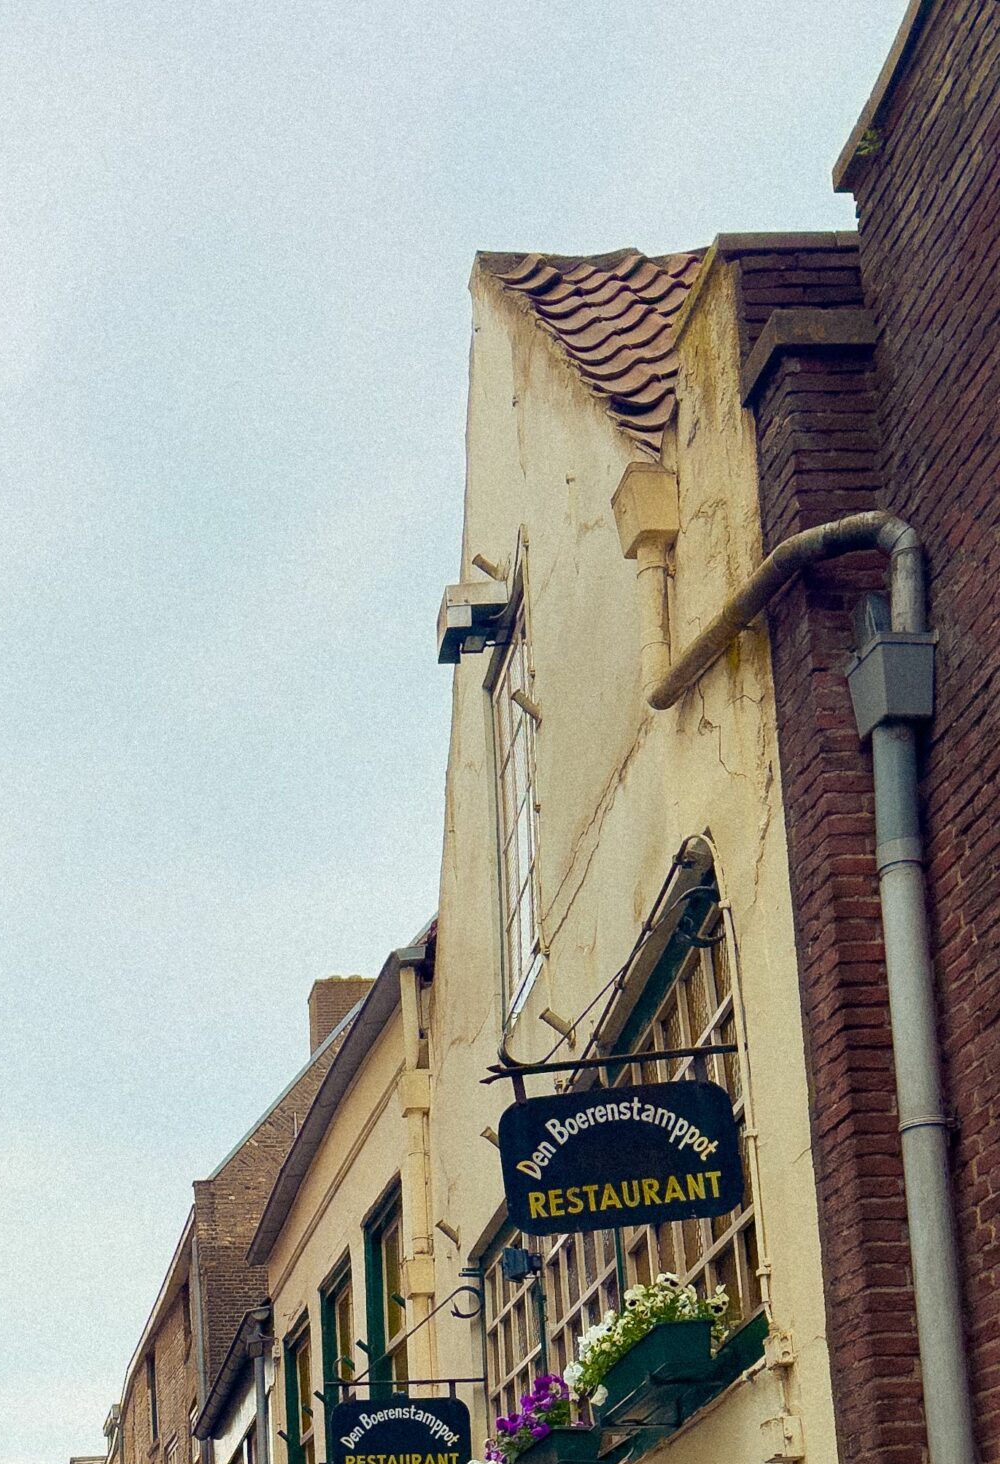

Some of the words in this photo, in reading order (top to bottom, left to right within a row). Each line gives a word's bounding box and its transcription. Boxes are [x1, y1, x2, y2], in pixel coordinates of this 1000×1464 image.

[516, 1140, 557, 1180] Den
[545, 1097, 719, 1161] Boerenstamppot
[528, 1170, 722, 1219] RESTAURANT
[340, 1426, 365, 1449] Den
[358, 1405, 460, 1447] Boerenstamppot
